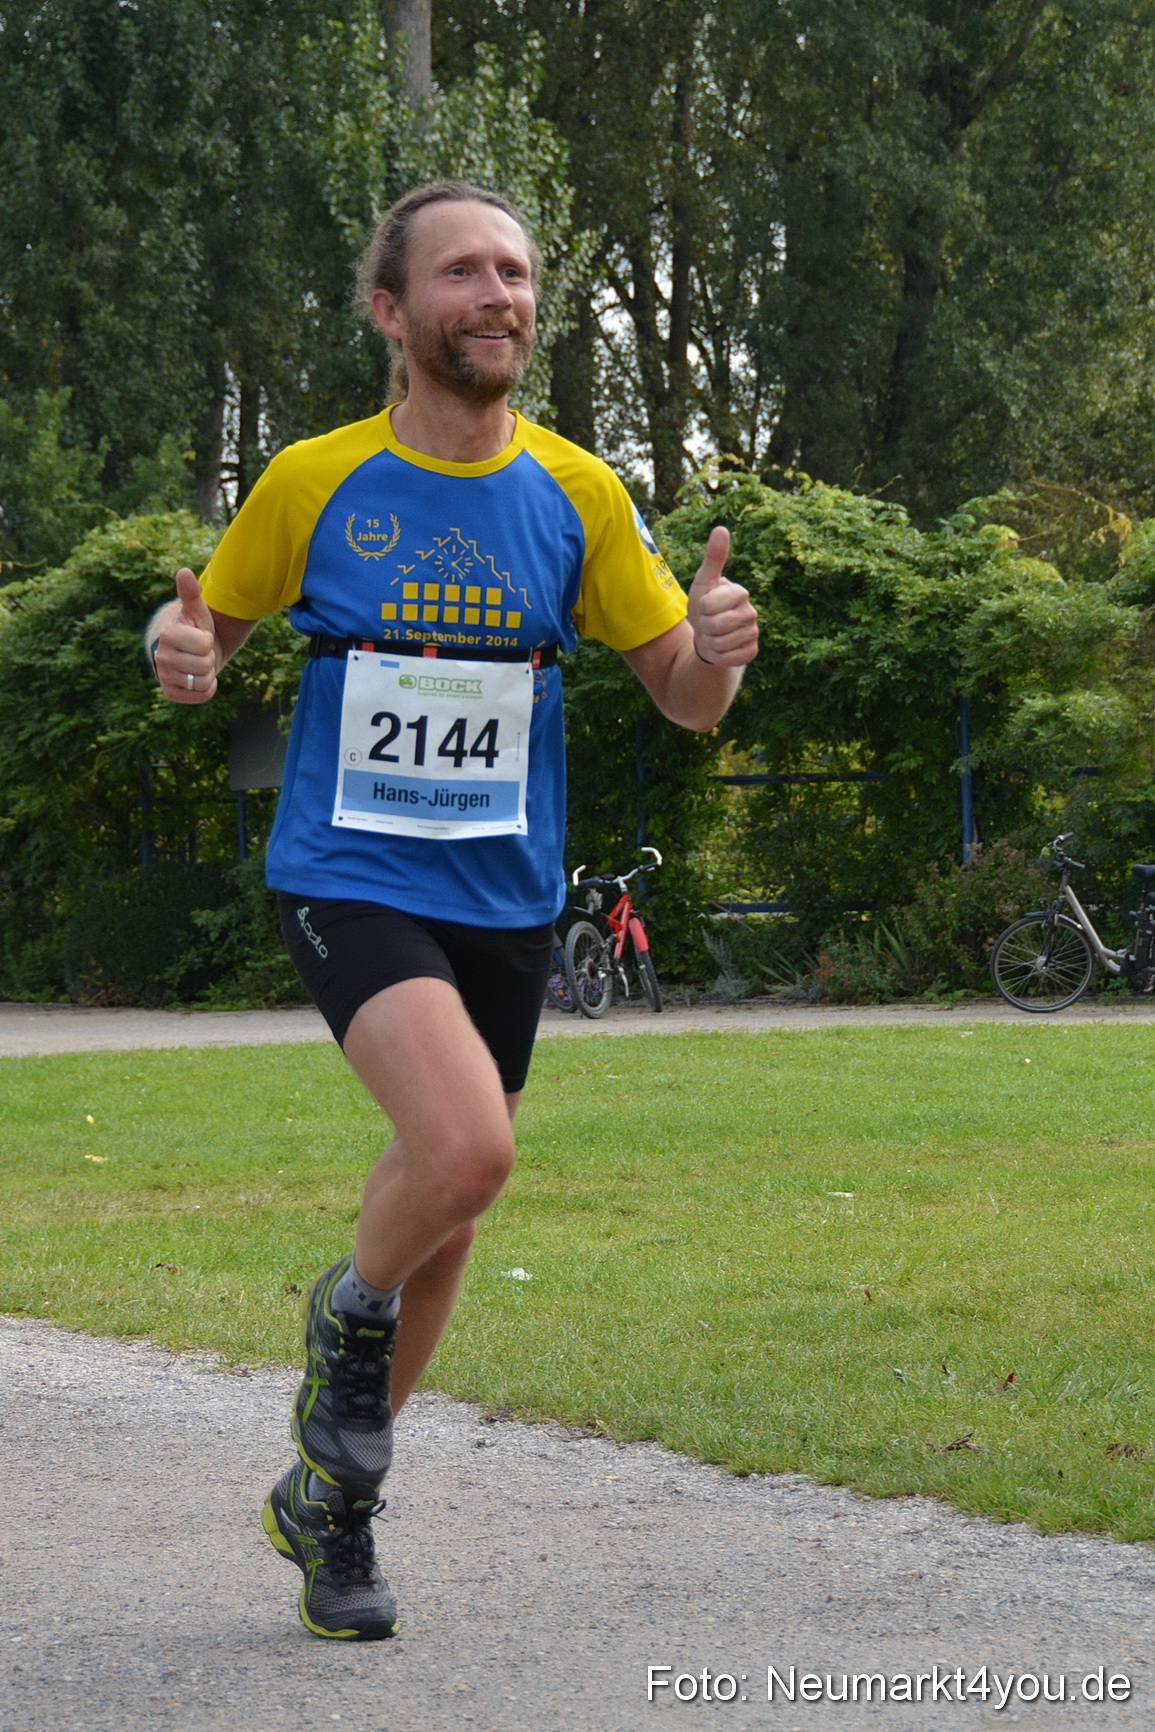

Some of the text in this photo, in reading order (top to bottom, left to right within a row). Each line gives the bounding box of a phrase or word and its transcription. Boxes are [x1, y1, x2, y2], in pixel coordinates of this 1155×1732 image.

[366, 519, 380, 528] 15
[357, 532, 388, 541] Jahre
[384, 629, 518, 647] 21.September 2014
[419, 676, 483, 692] BOCK
[368, 711, 499, 769] 2144
[350, 752, 356, 762] C
[373, 781, 490, 811] Hans-Jürgen
